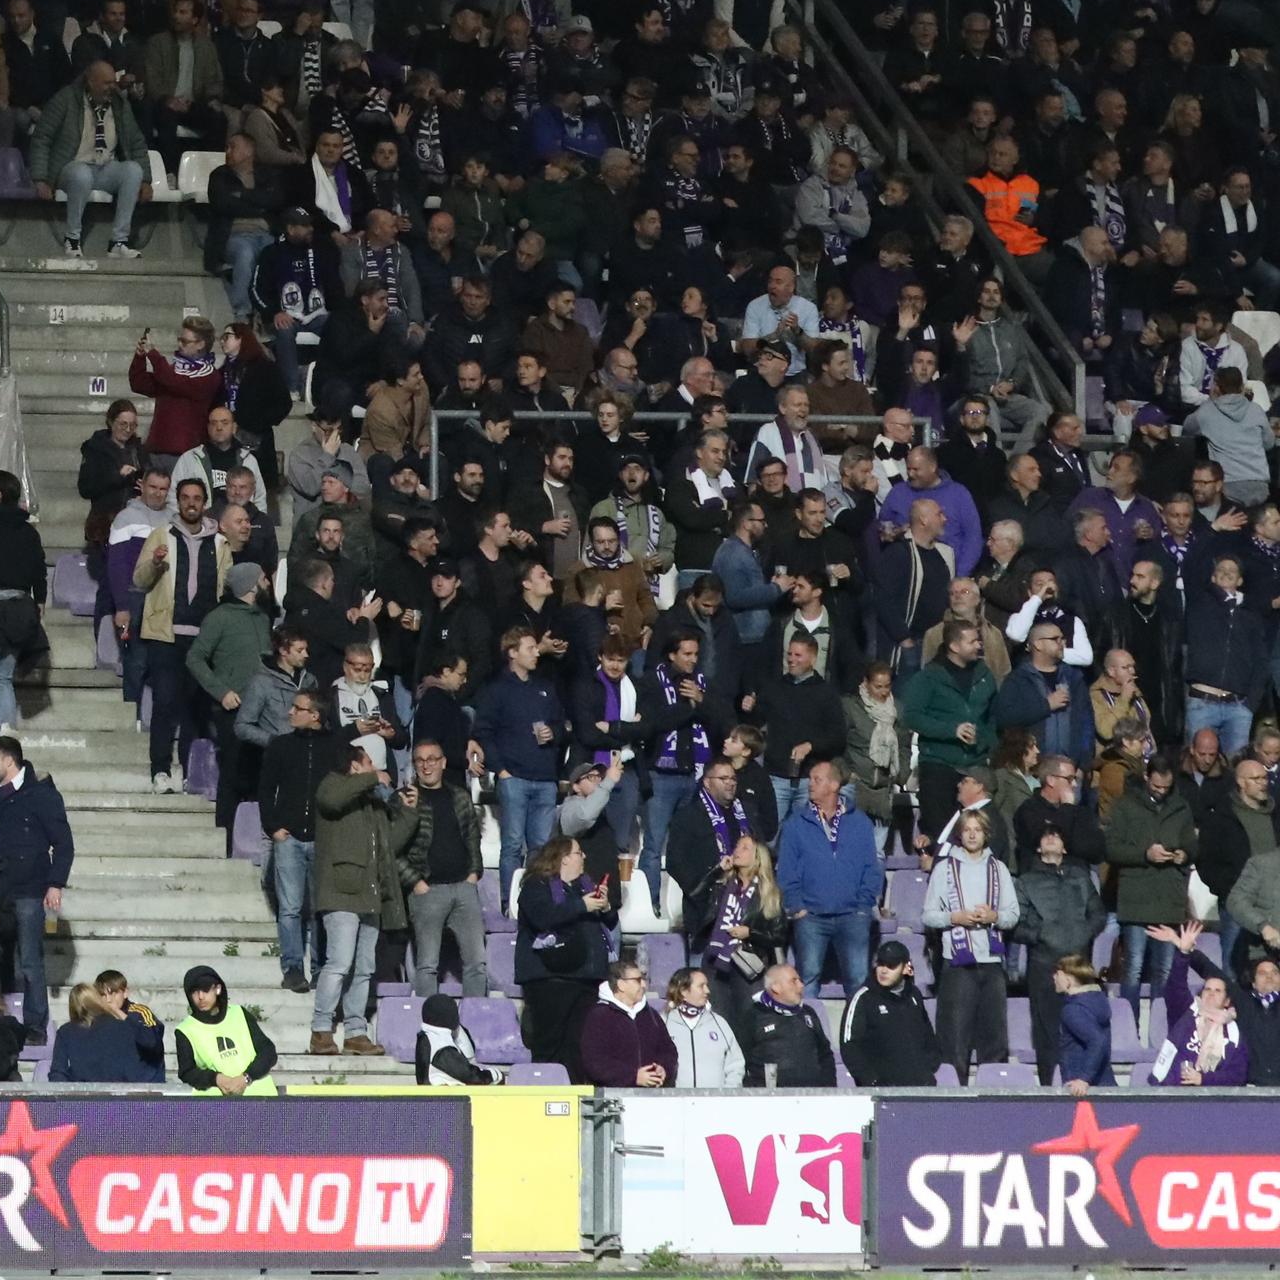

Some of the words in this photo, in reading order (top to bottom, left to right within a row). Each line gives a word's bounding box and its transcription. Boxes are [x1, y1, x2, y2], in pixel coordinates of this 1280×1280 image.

[52, 308, 64, 321] 14
[91, 378, 105, 393] M
[94, 1171, 352, 1235] CASINO
[376, 1182, 435, 1223] TV
[902, 1152, 1110, 1249] STAR
